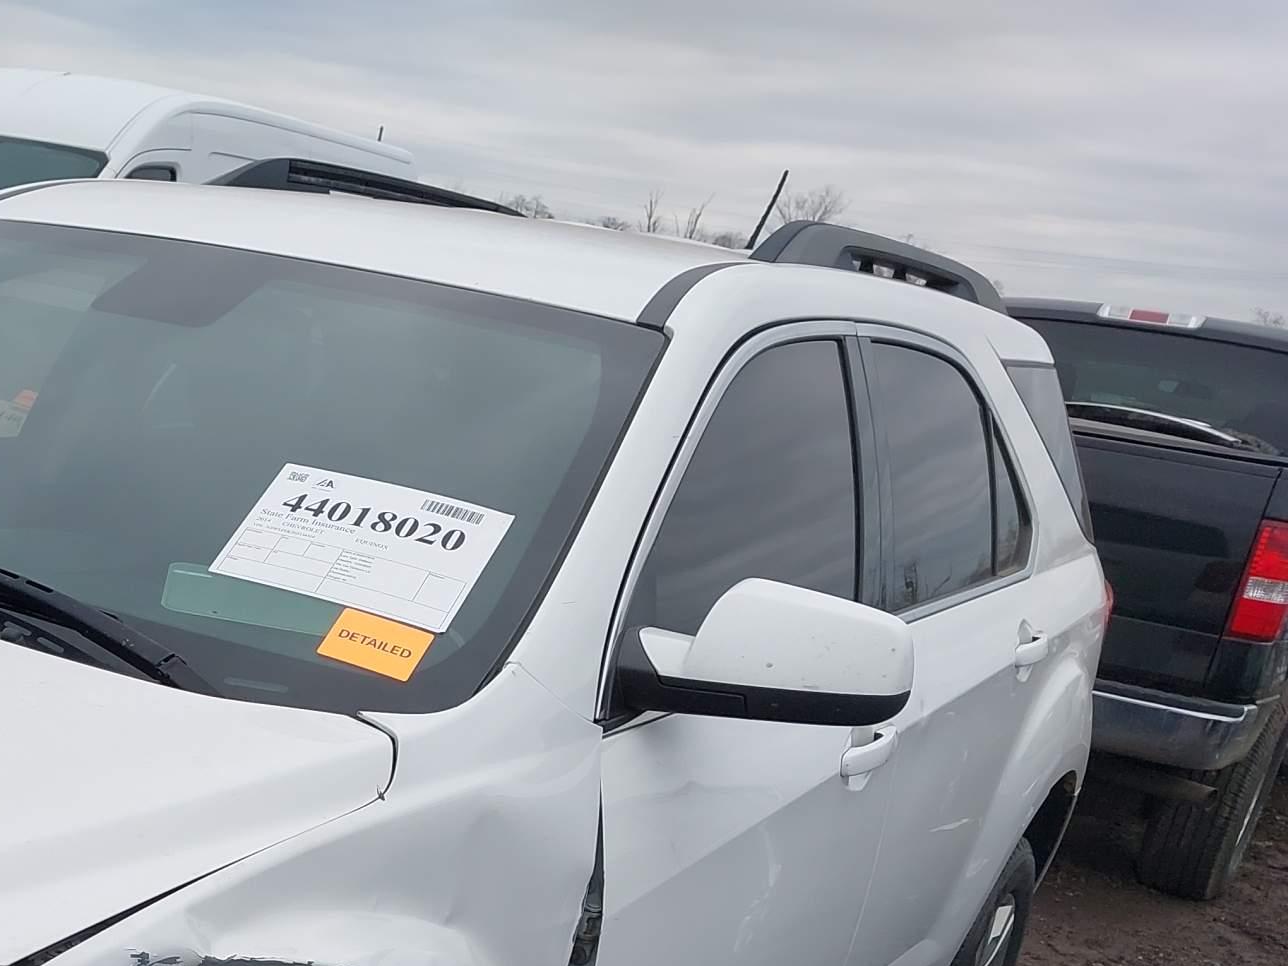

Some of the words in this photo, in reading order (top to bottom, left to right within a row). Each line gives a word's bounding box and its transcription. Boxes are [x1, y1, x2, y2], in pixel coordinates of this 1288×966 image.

[260, 508, 285, 519] State
[285, 513, 310, 525] Farm
[311, 518, 357, 535] Insurance
[281, 521, 326, 535] CHEVROLET
[355, 537, 389, 551] EQUINOX
[282, 493, 467, 552] 44018020
[338, 628, 412, 660] DETAILED
